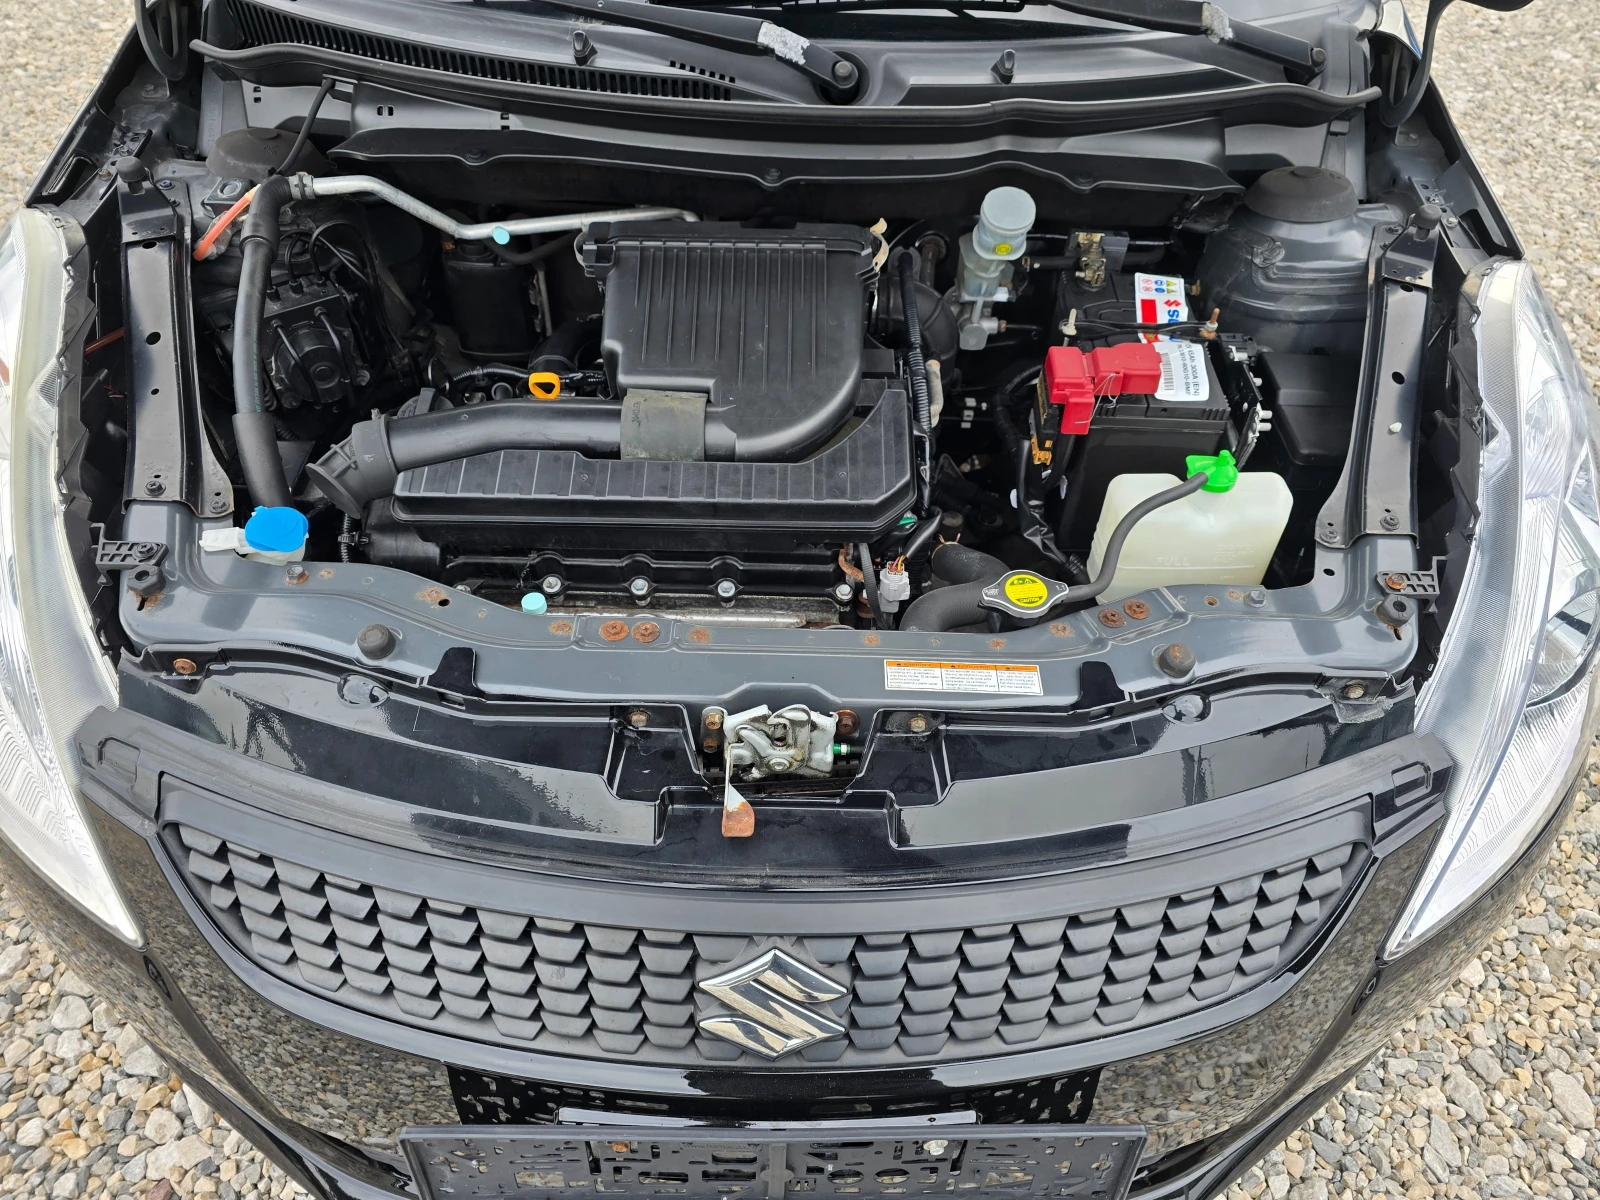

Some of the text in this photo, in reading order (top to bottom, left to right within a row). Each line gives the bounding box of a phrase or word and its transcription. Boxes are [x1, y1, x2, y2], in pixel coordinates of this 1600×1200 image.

[1190, 364, 1199, 380] 300A
[1192, 381, 1200, 396] (EN)
[1156, 557, 1191, 566] FULL
